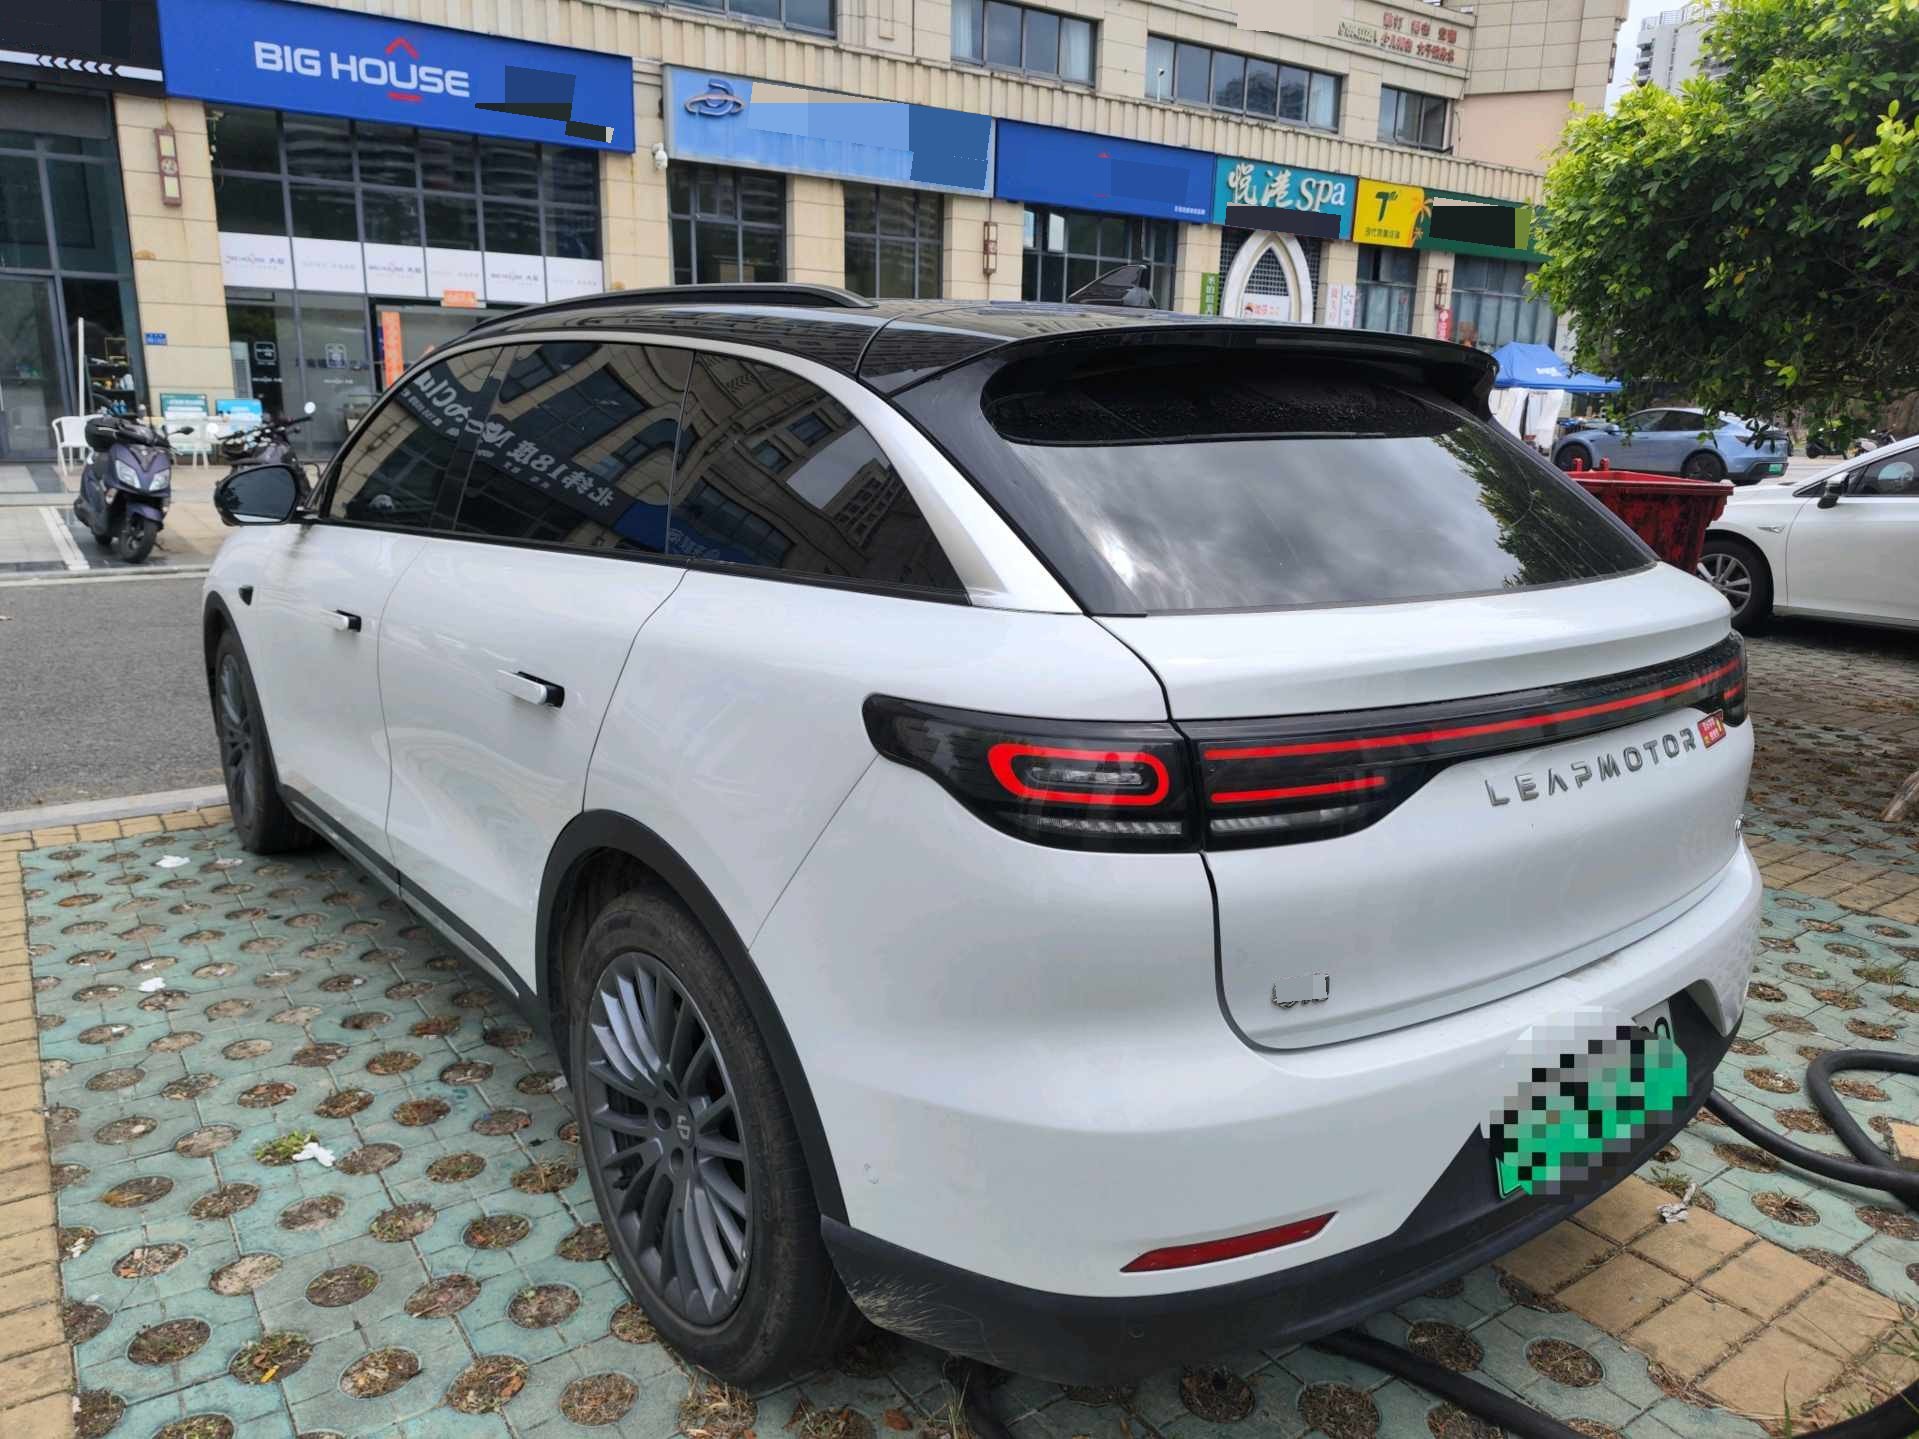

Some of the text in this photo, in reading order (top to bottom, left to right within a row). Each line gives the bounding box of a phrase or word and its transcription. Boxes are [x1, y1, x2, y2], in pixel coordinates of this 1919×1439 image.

[254, 41, 471, 98] BIG HOUSE
[1484, 727, 1697, 807] LEAPMOTOR
